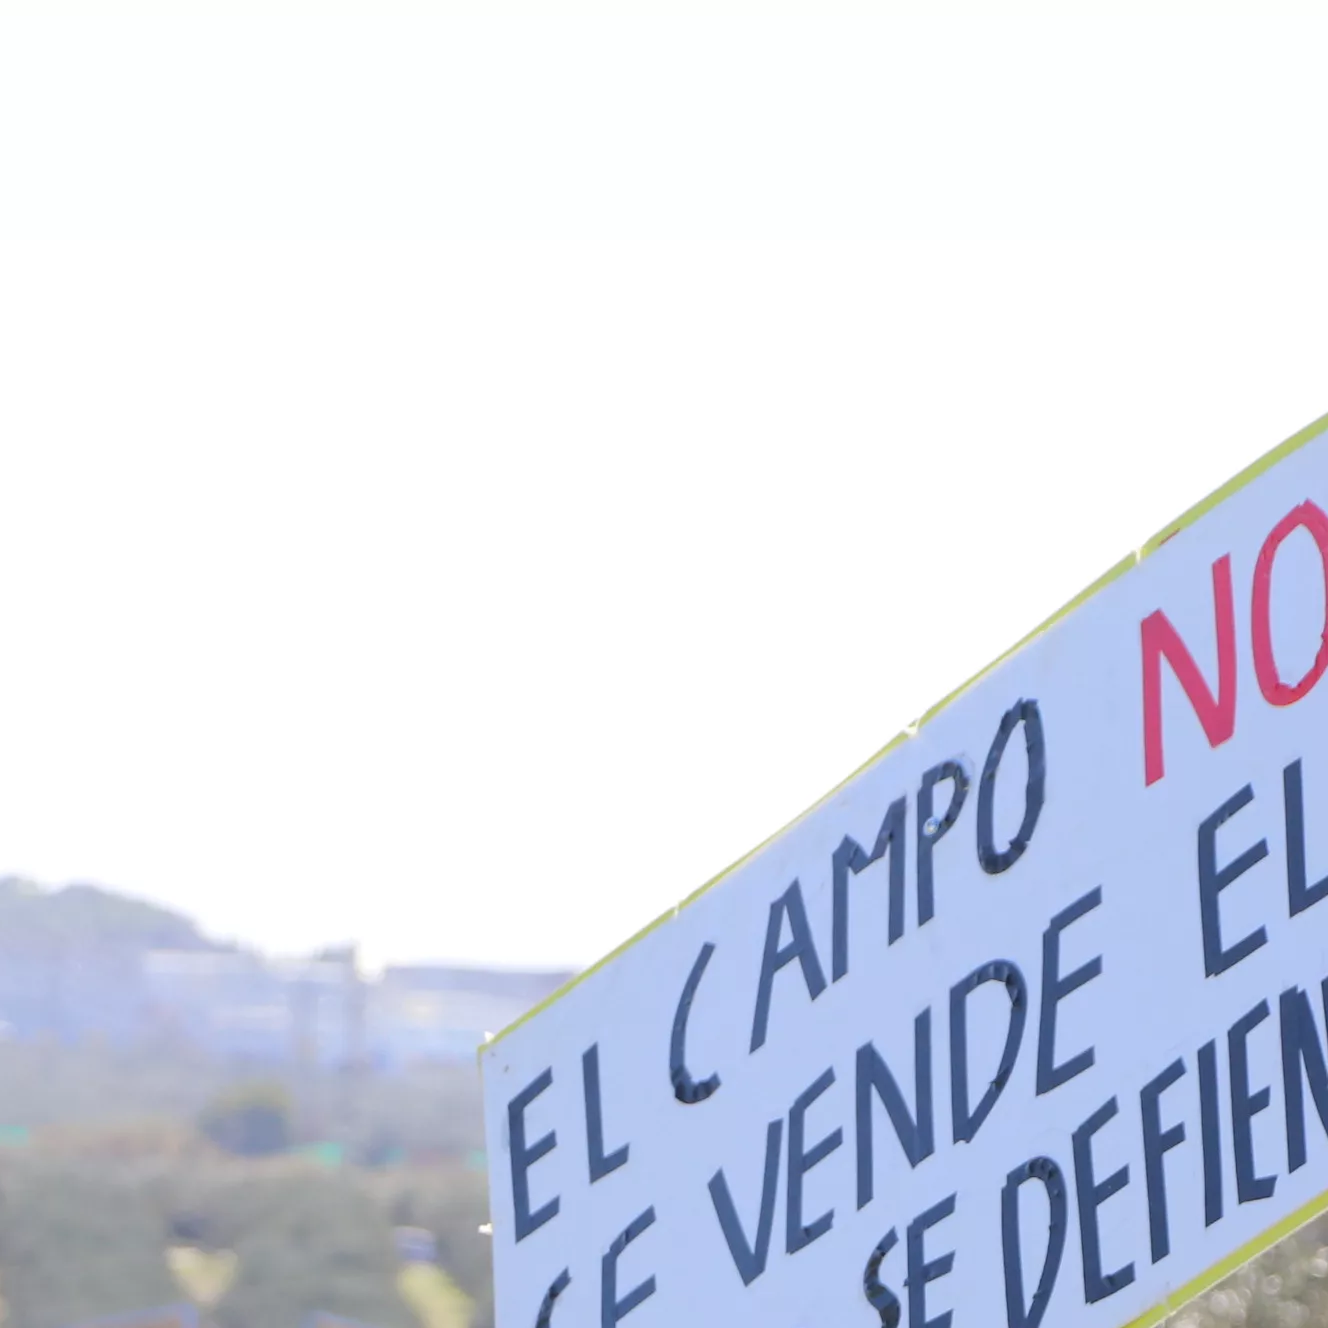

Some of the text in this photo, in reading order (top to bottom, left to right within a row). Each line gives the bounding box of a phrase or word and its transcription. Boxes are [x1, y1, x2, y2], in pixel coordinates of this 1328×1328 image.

[507, 1042, 630, 1244] EL
[670, 697, 1047, 1105] CAMPO
[707, 884, 1103, 1287] VENDE
